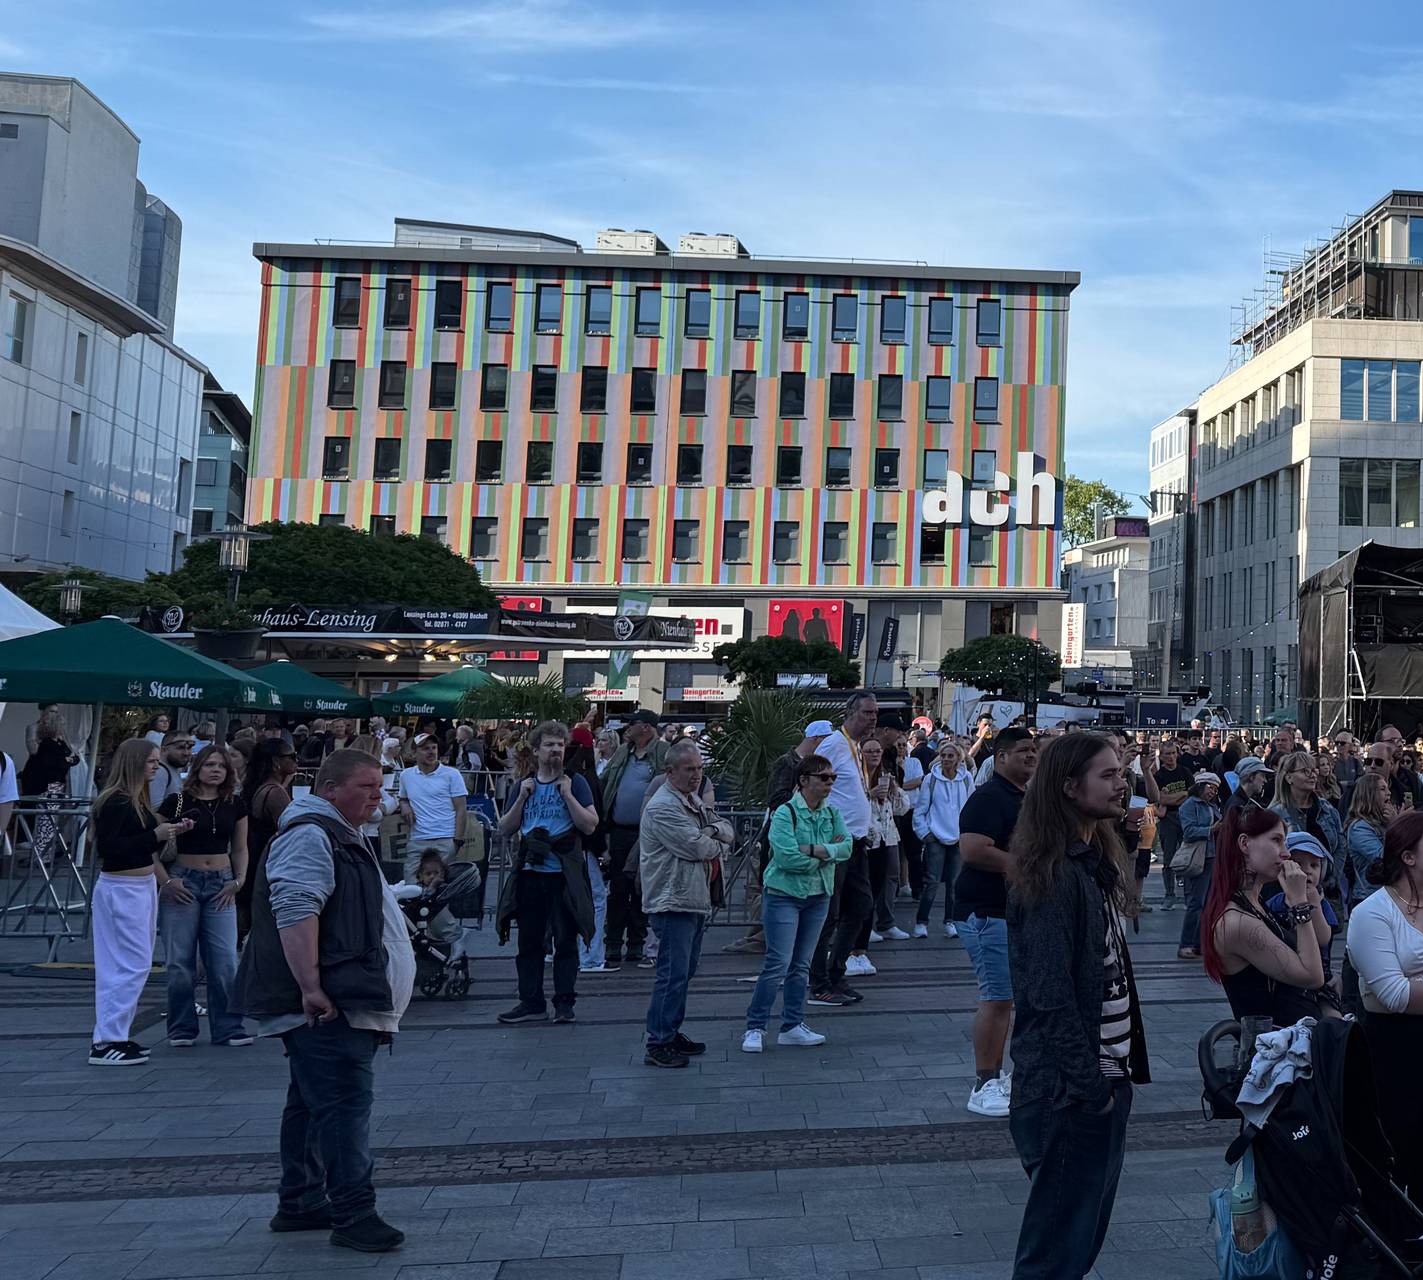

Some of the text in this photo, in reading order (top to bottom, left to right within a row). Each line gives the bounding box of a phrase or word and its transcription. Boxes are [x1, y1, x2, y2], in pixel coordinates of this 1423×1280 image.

[250, 607, 377, 632] nhaus-Lensing
[149, 680, 203, 700] Stauder
[315, 699, 348, 711] Stauder
[403, 702, 435, 714] Stauder
